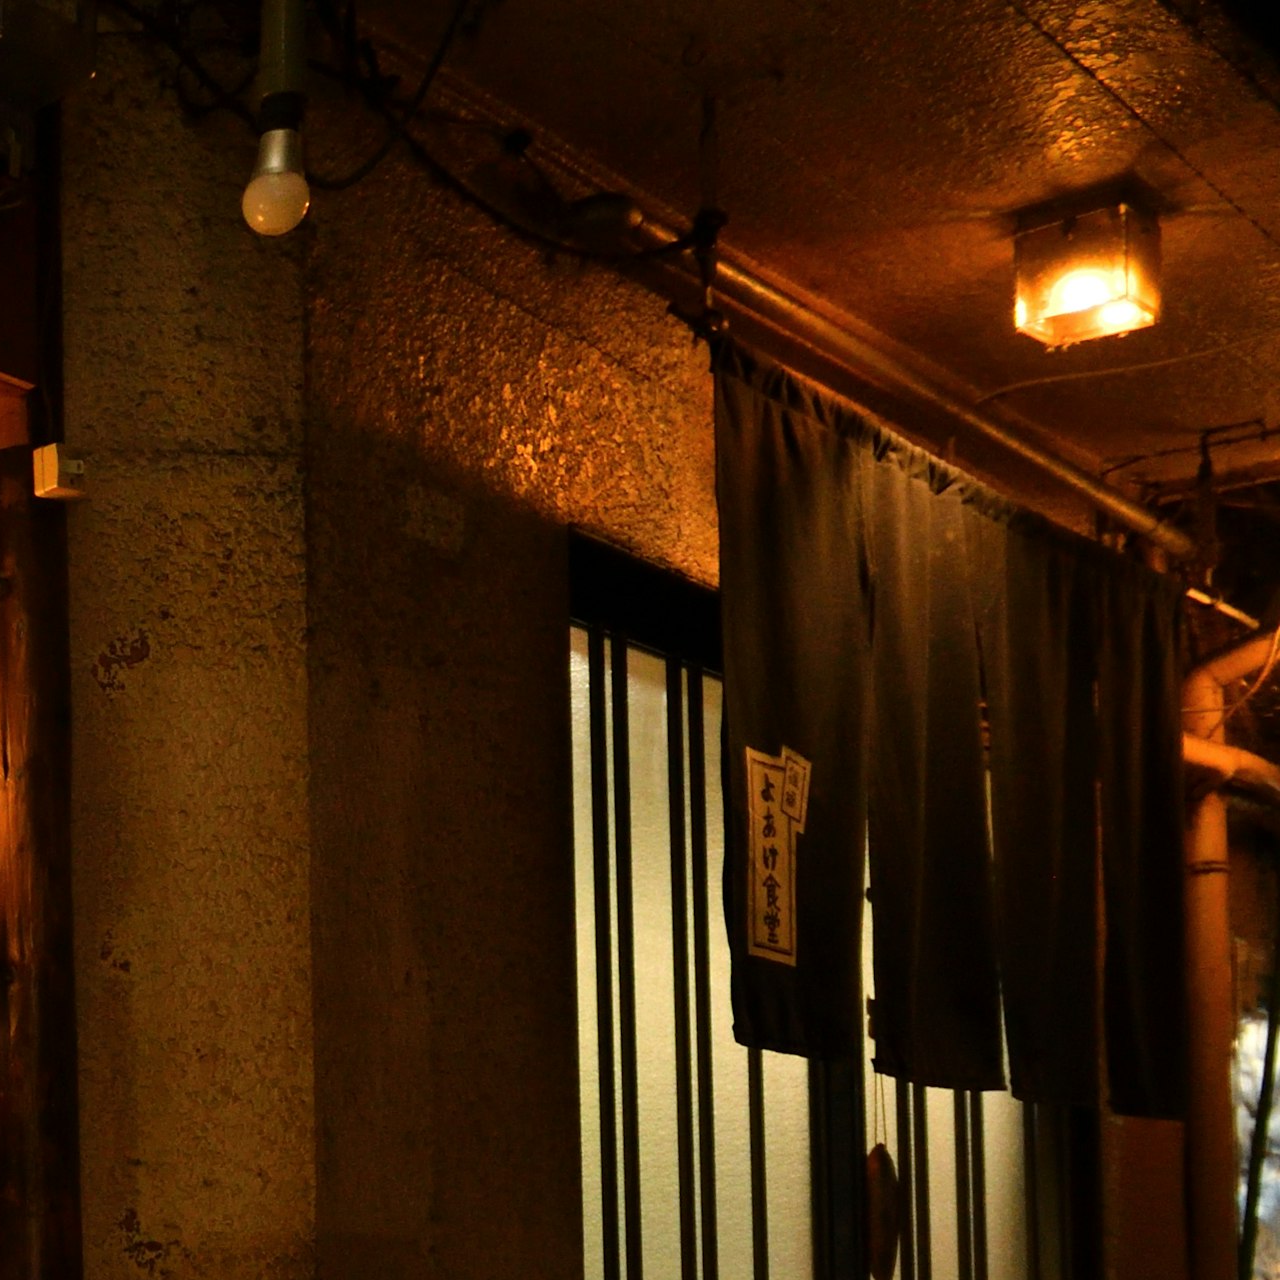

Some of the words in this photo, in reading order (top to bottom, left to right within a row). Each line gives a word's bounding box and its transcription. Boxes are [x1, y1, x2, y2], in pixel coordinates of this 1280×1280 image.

[761, 774, 781, 944] よあけ食堂
